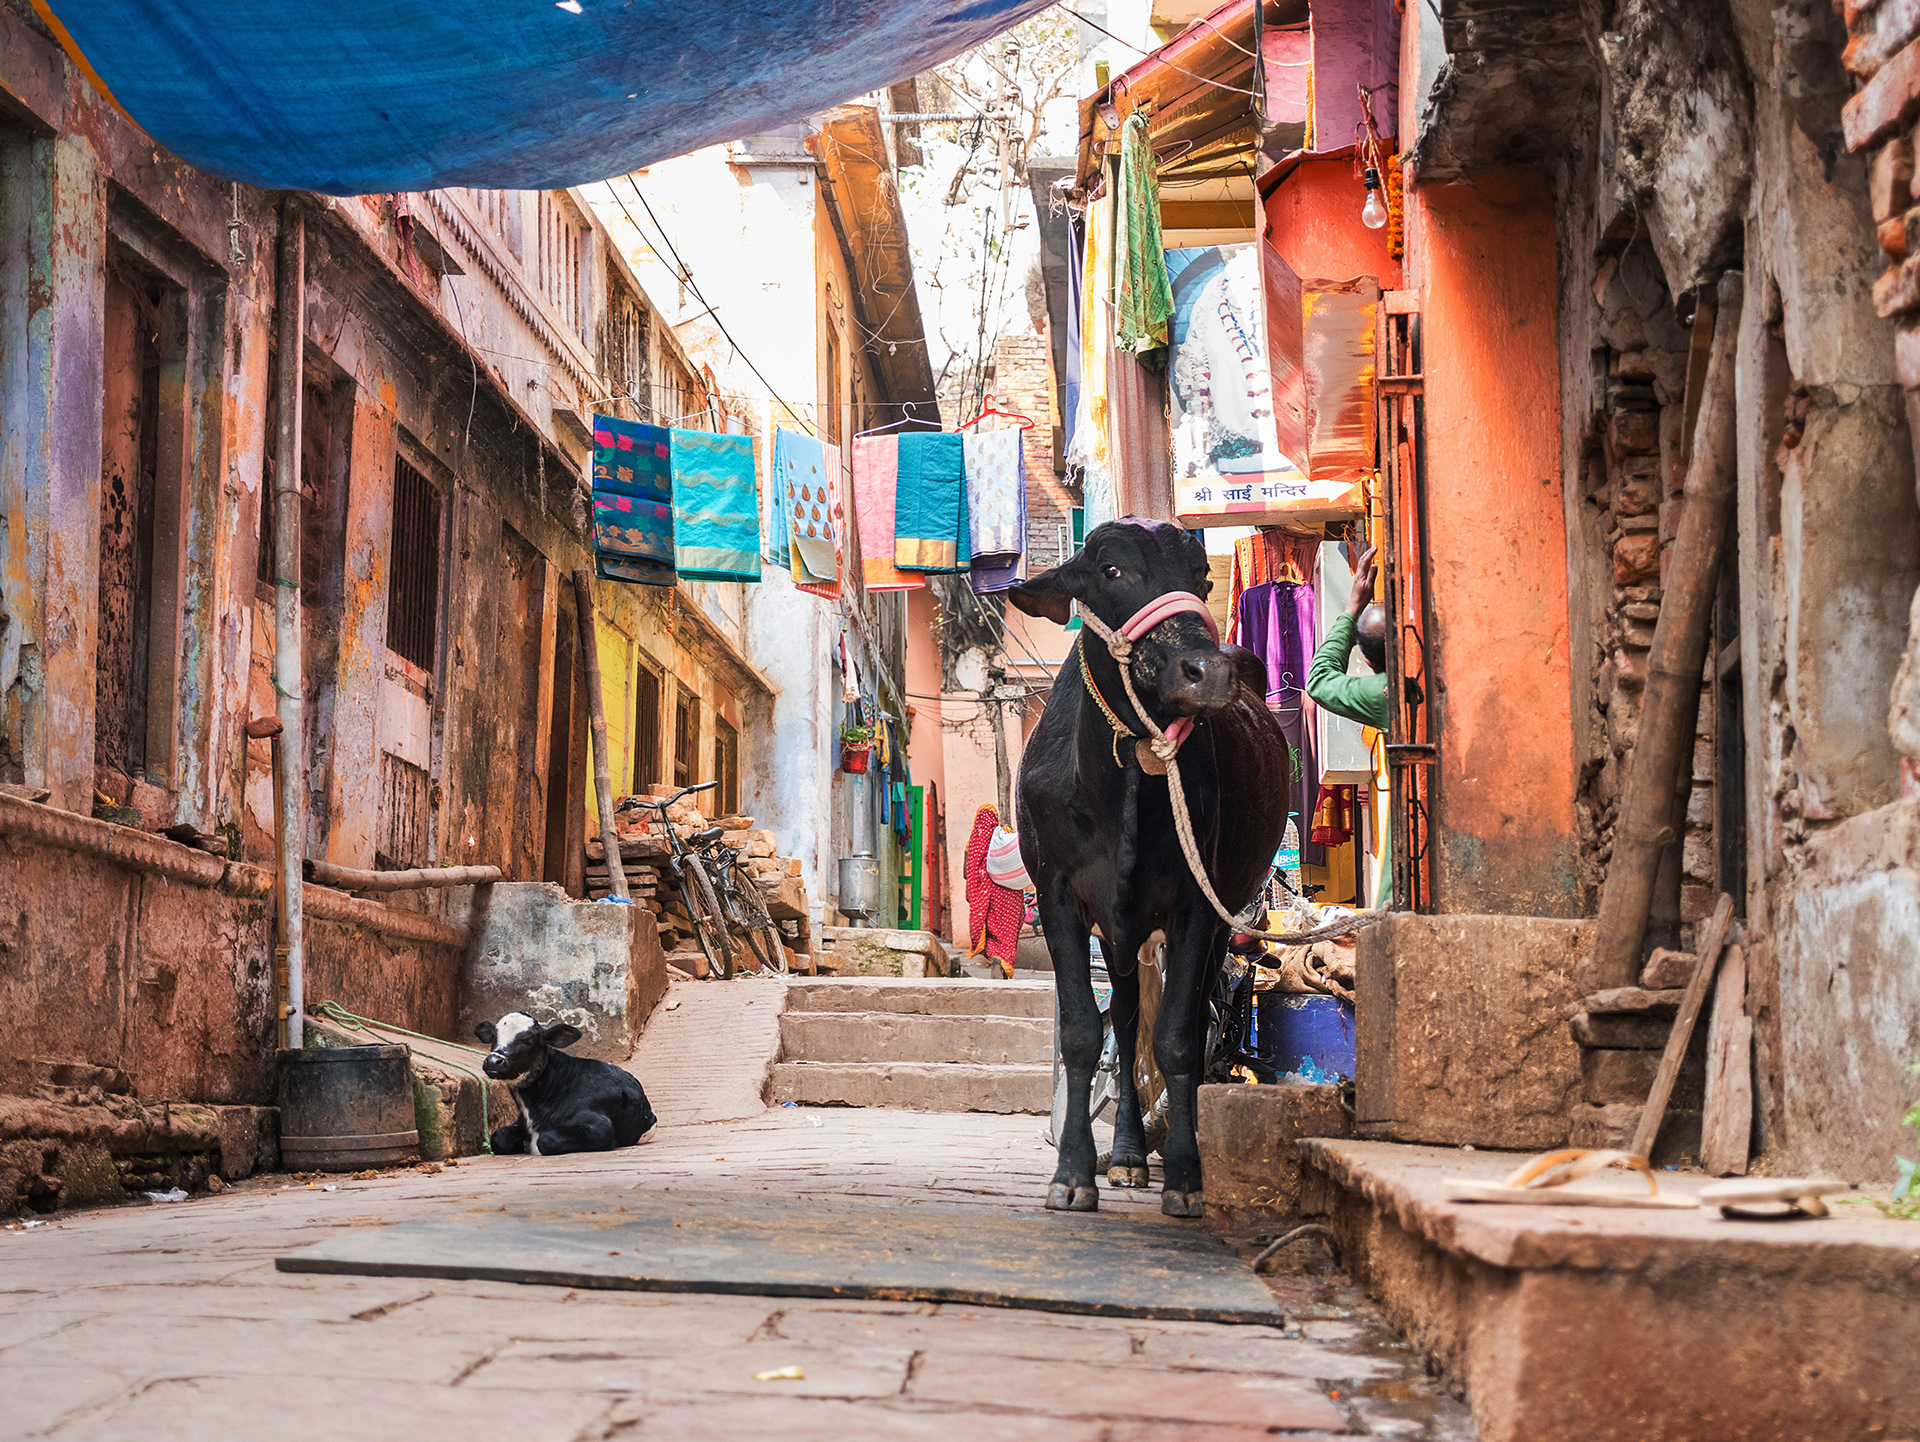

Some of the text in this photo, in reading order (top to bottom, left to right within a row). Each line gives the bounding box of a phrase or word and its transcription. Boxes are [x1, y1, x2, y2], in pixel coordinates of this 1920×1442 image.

[1194, 486, 1212, 501] श्री
[1260, 482, 1307, 498] मन्दिर
[1279, 853, 1300, 864] Bisle
